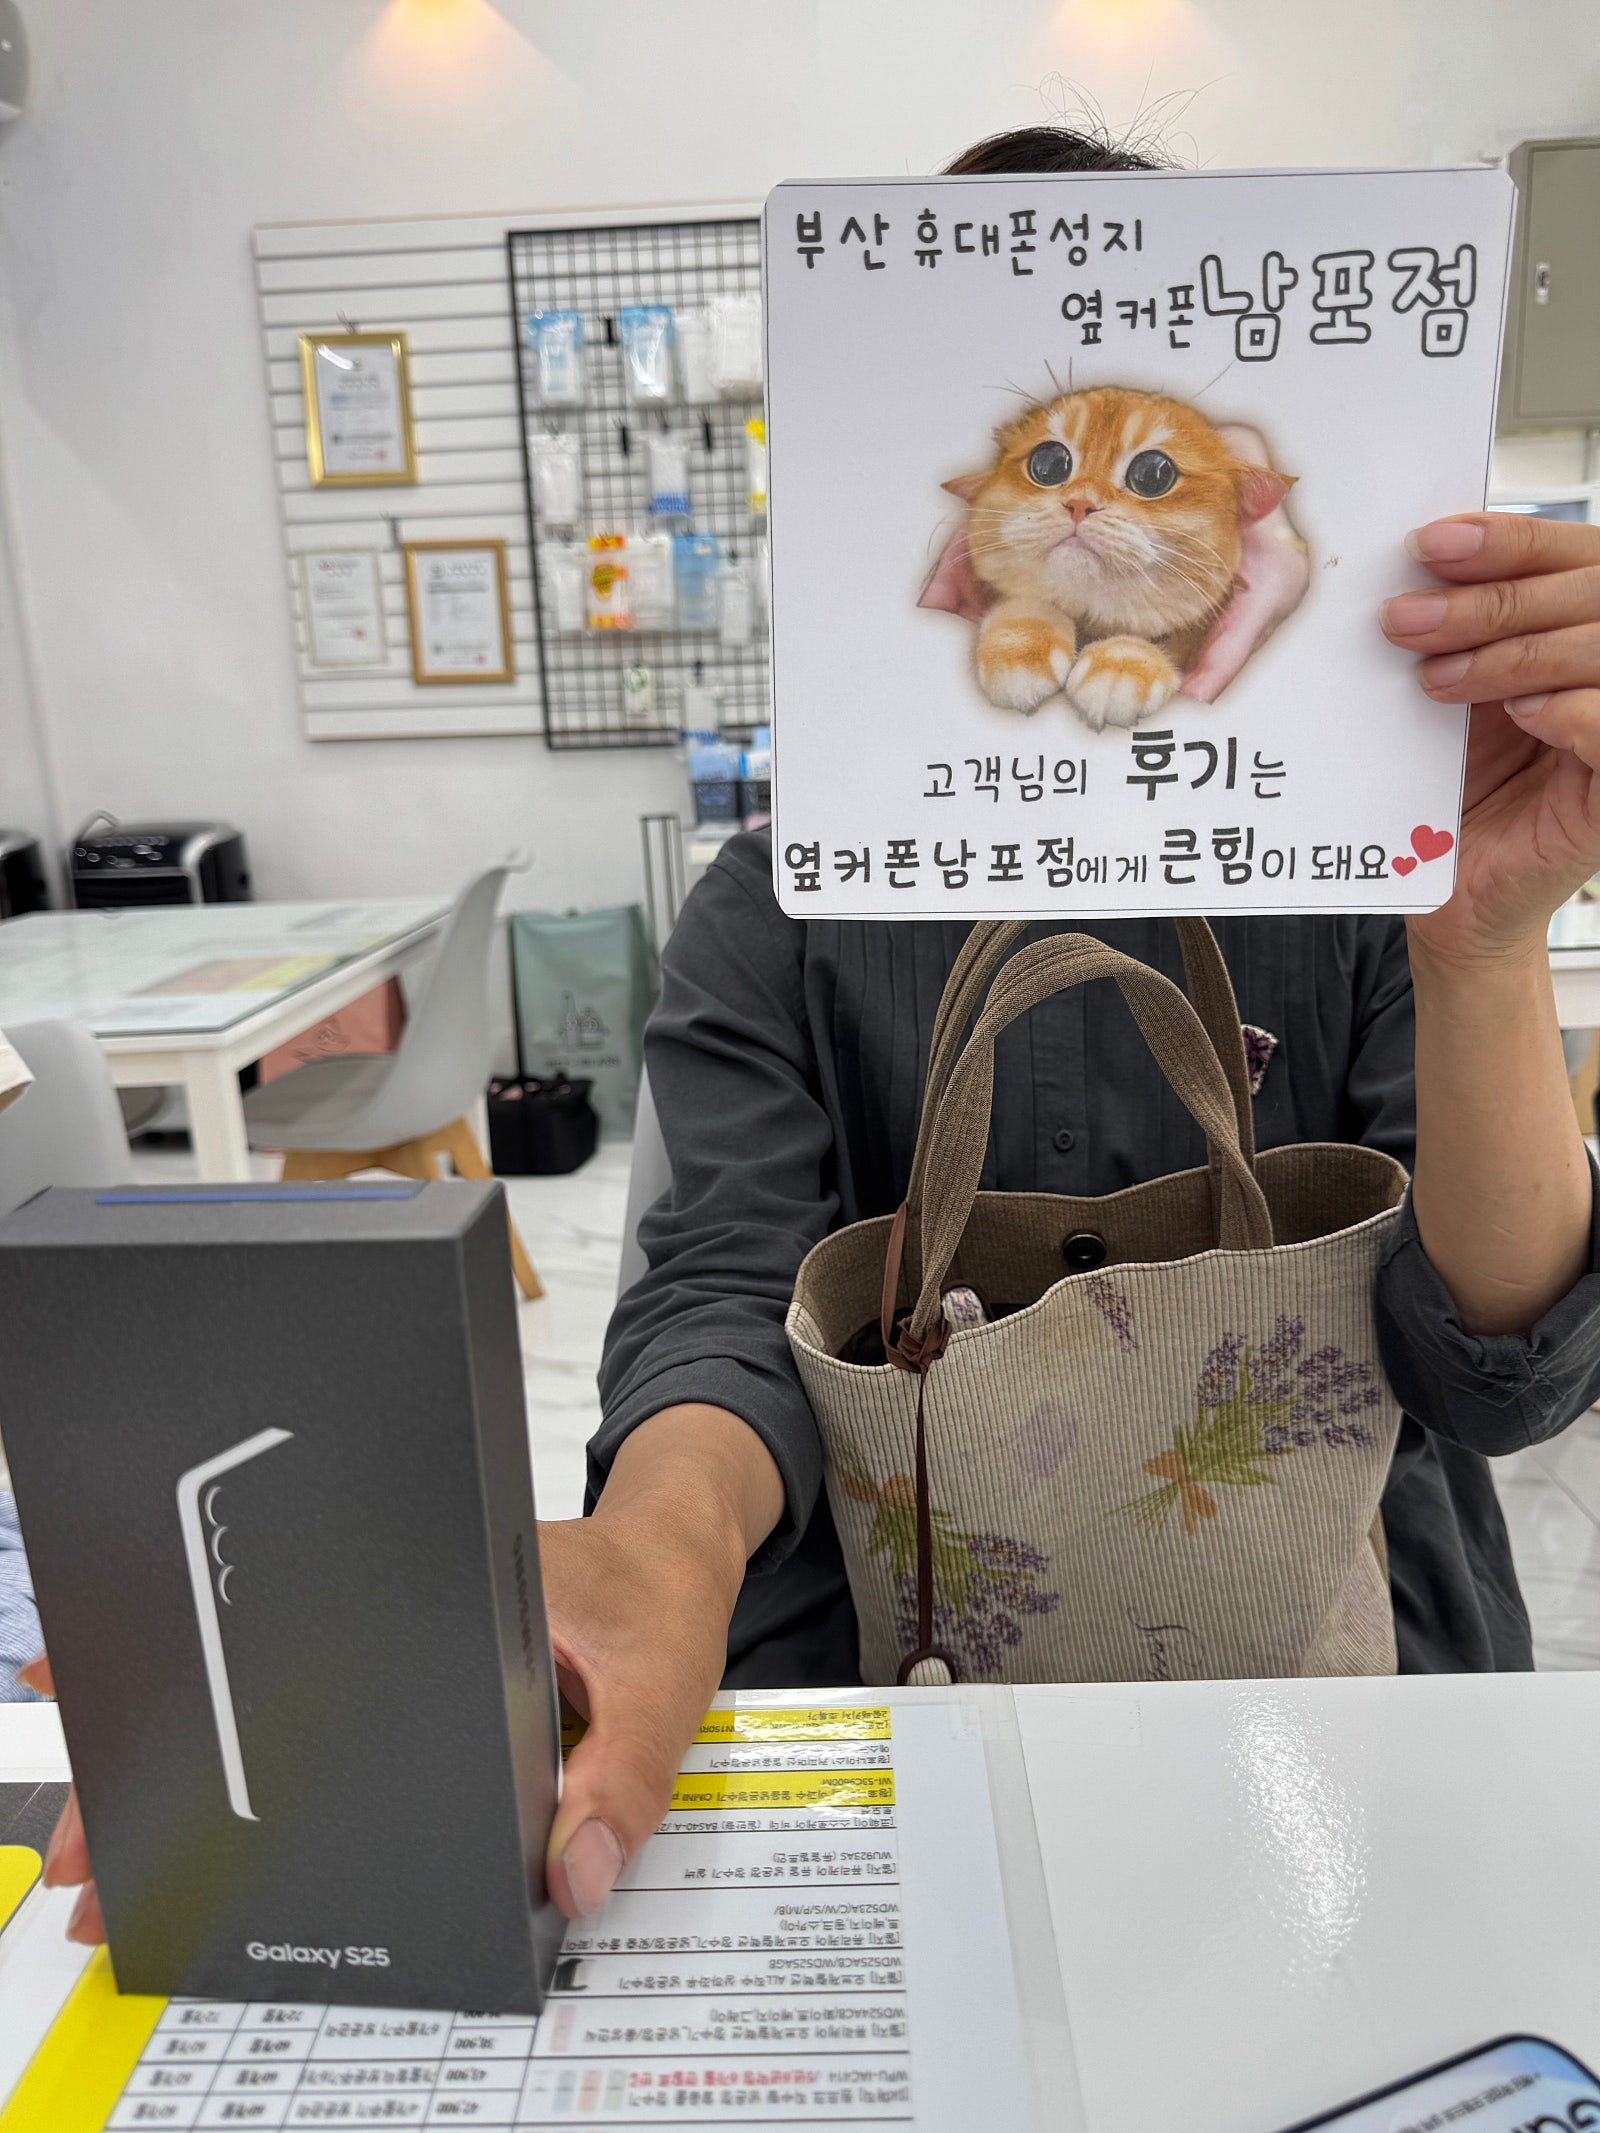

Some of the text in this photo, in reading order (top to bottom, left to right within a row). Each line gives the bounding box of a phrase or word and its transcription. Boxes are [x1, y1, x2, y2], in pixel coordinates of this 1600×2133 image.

[796, 208, 1144, 277] 부산 휴대폰성지
[1061, 243, 1479, 362] 옆커폰 남포점
[922, 729, 1287, 803] 고객님의 후기는
[1311, 845, 1390, 882] 돼요
[786, 1756, 828, 1765] 커피머신
[682, 1793, 712, 1801] OMNI
[675, 1822, 718, 1831] BAS40-A
[769, 1820, 790, 1829] 비데
[840, 1851, 891, 1861] WU923AS
[712, 1869, 745, 1879] 정수기
[751, 1866, 784, 1878] 냉온정
[788, 1867, 812, 1876] 듀얼
[817, 1865, 862, 1876] 퓨리케어
[866, 1863, 896, 1874] [엘지]
[816, 1934, 864, 1946] 퓨리케어
[247, 1942, 391, 1969] Galaxy S25
